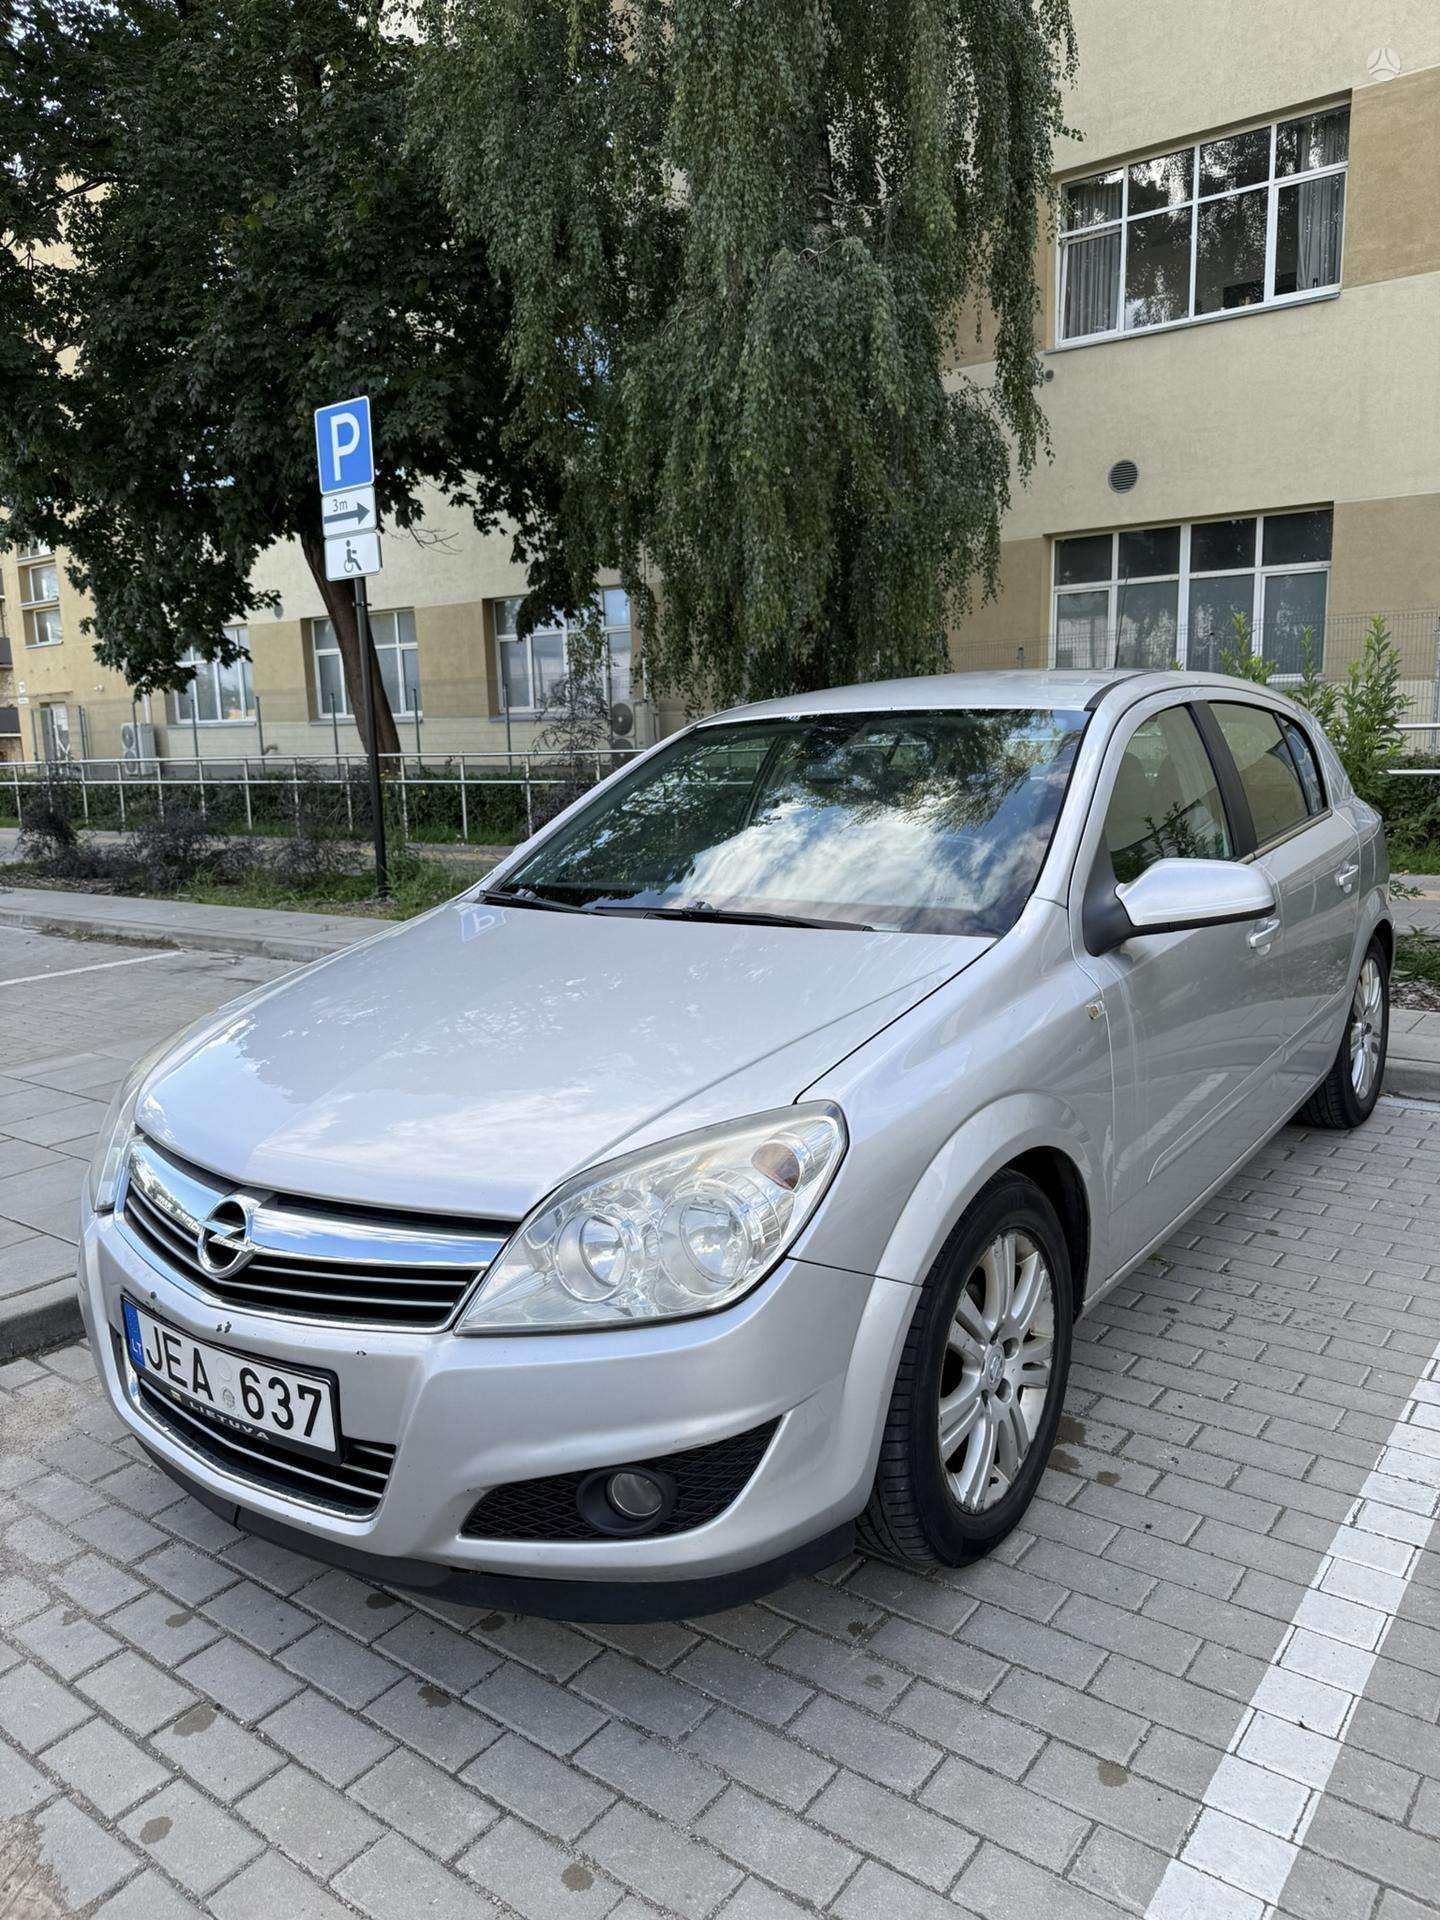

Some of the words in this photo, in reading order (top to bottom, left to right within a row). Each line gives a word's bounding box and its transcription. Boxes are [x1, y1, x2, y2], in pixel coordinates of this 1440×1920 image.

[330, 412, 360, 481] P
[332, 498, 348, 512] 3m
[131, 1338, 142, 1356] LT
[146, 1324, 214, 1402] JEA
[239, 1367, 322, 1438] 637
[188, 1401, 270, 1441] LIETUVA
